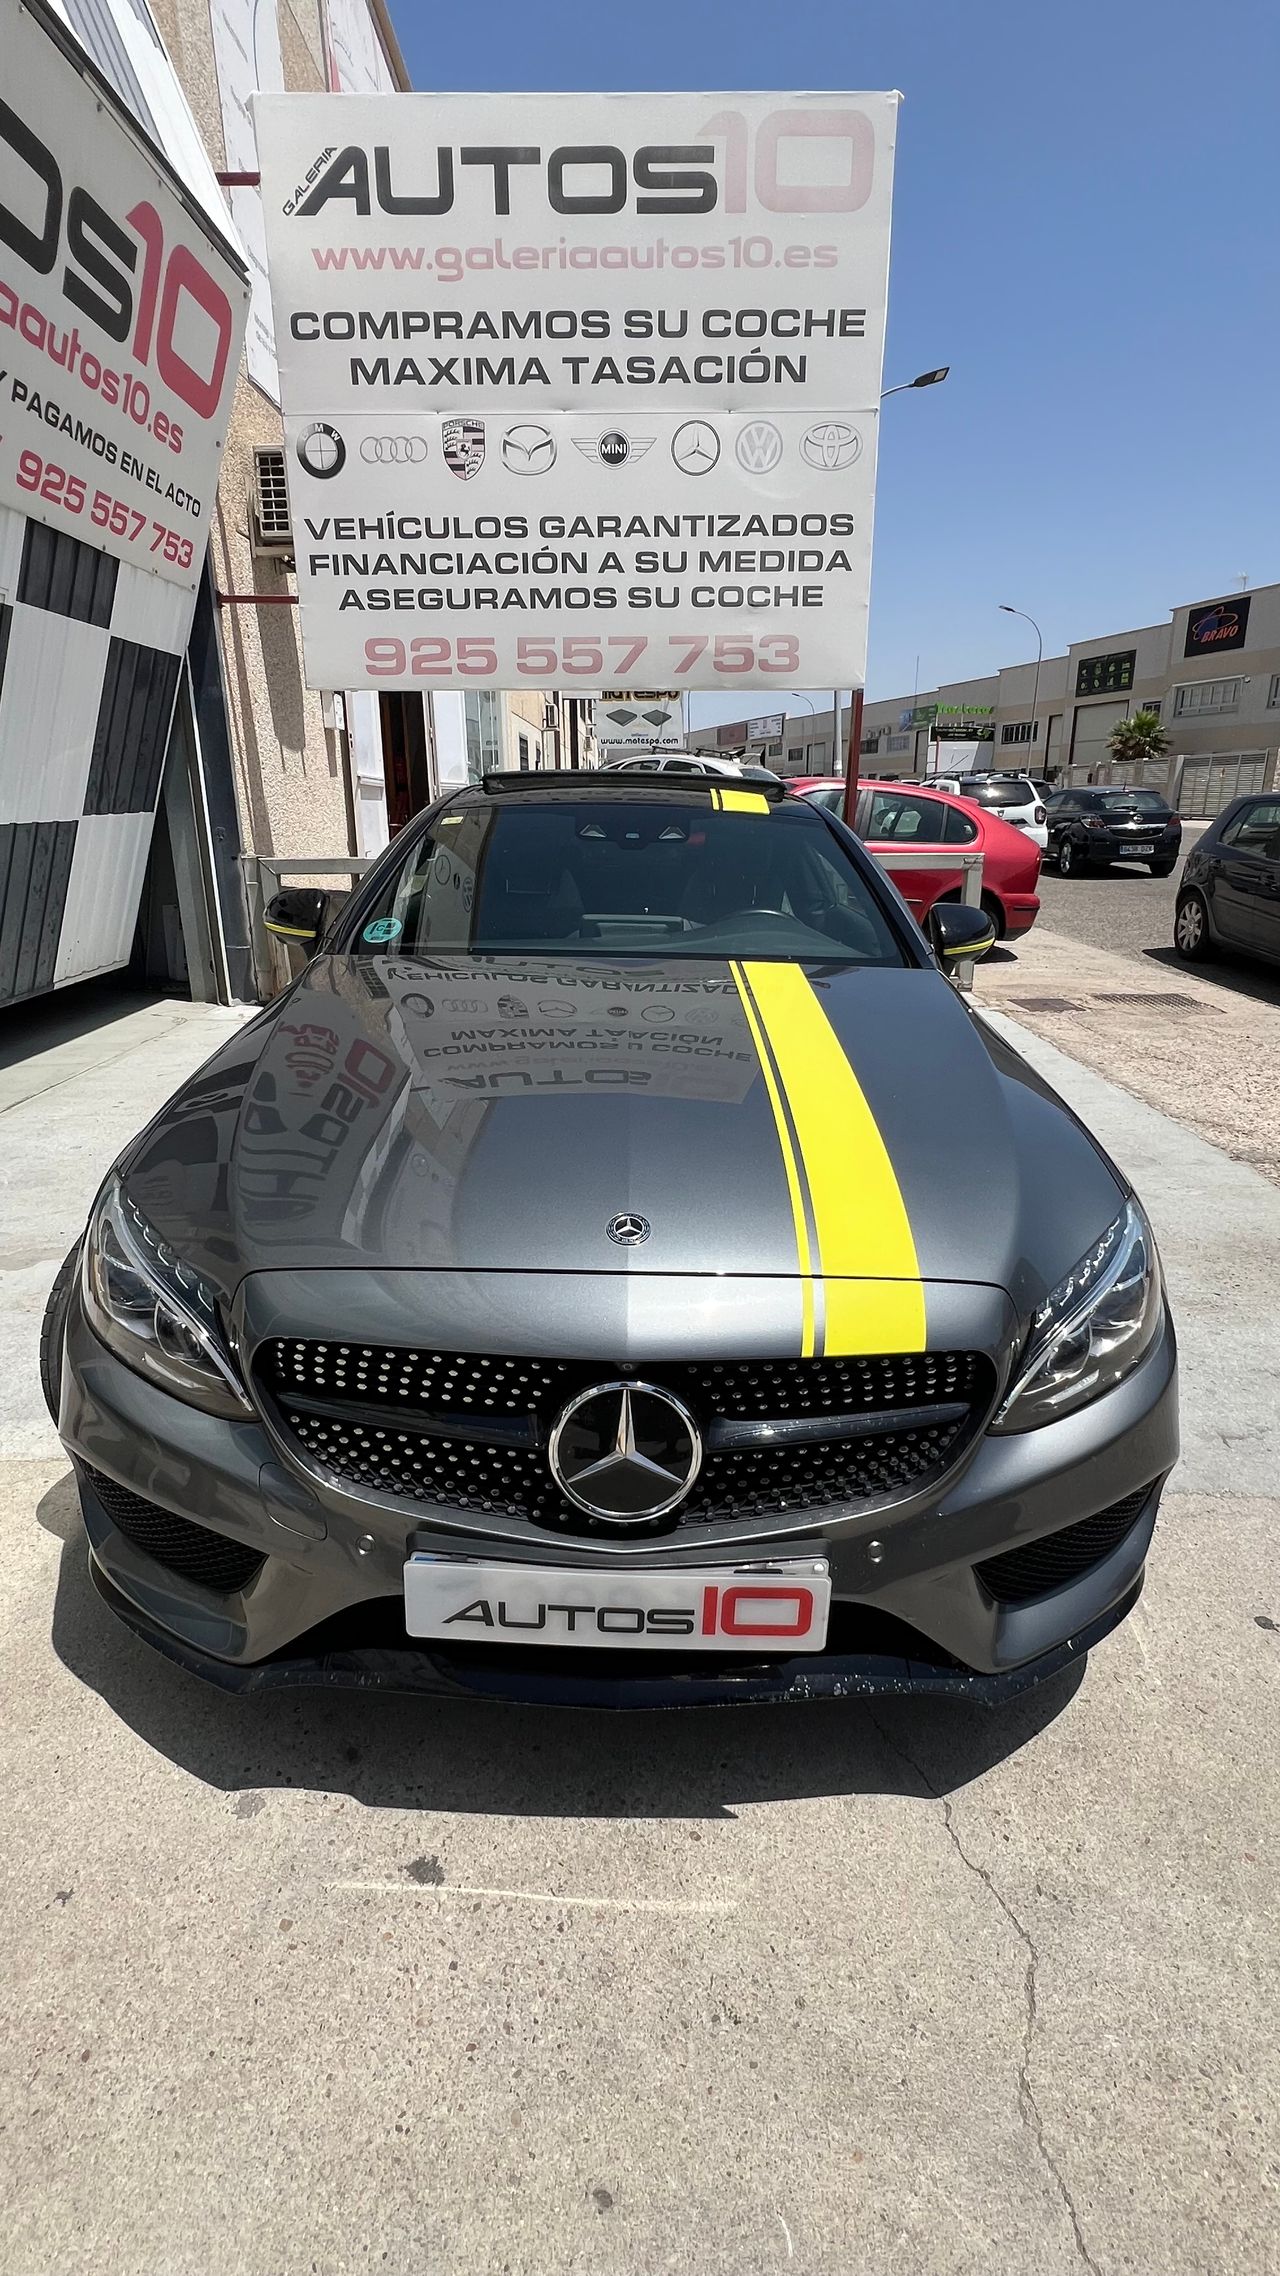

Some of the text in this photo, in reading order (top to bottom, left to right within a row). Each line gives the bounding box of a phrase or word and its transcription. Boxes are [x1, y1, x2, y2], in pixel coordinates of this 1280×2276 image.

[282, 147, 338, 216] GALERIA
[294, 110, 874, 216] AUTOS10
[311, 237, 838, 282] www.galeriaautos10.es
[291, 310, 610, 340] COMPRAMOS
[625, 310, 687, 338] SU
[703, 309, 866, 337] COCHE
[351, 346, 806, 386] MAXIMA TASACIÓN
[11, 378, 201, 518] PAGAMOS EN EL ACTO
[601, 443, 627, 455] MINI
[16, 449, 194, 569] 925 557 753
[304, 511, 854, 541] VEHÍCULOS GARANTIZADOS
[309, 546, 853, 576] FINANCIACIÓN A SU MEDIDA
[339, 586, 824, 611] ASEGURAMOS SU COCHE
[1200, 625, 1239, 644] BRAVO
[364, 635, 801, 678] 925 557 753
[600, 737, 679, 747] www.matespo.com
[441, 1586, 814, 1637] AUTOS10
